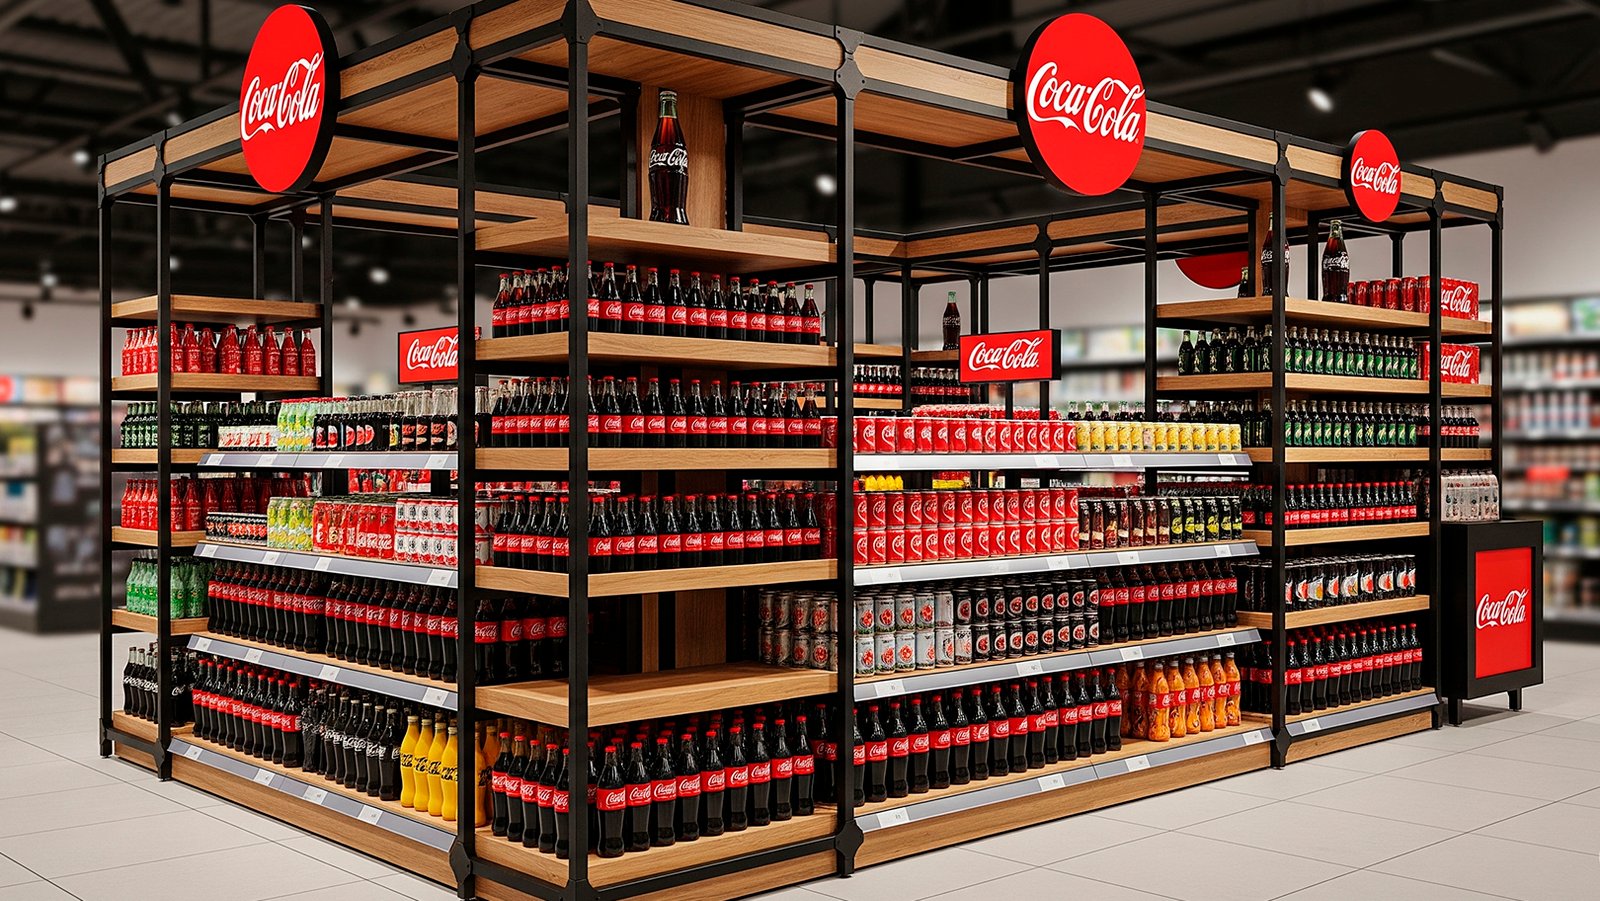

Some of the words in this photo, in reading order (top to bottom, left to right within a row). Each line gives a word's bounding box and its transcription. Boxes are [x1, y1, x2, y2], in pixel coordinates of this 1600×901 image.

[241, 51, 324, 141] Coca-Cola
[1027, 62, 1145, 142] Coca-Cola
[1351, 156, 1401, 195] Coca-Cola
[407, 334, 459, 370] Coca-Cola
[968, 337, 1044, 371] Coca-Cola
[1476, 588, 1529, 629] Coca-Cola
